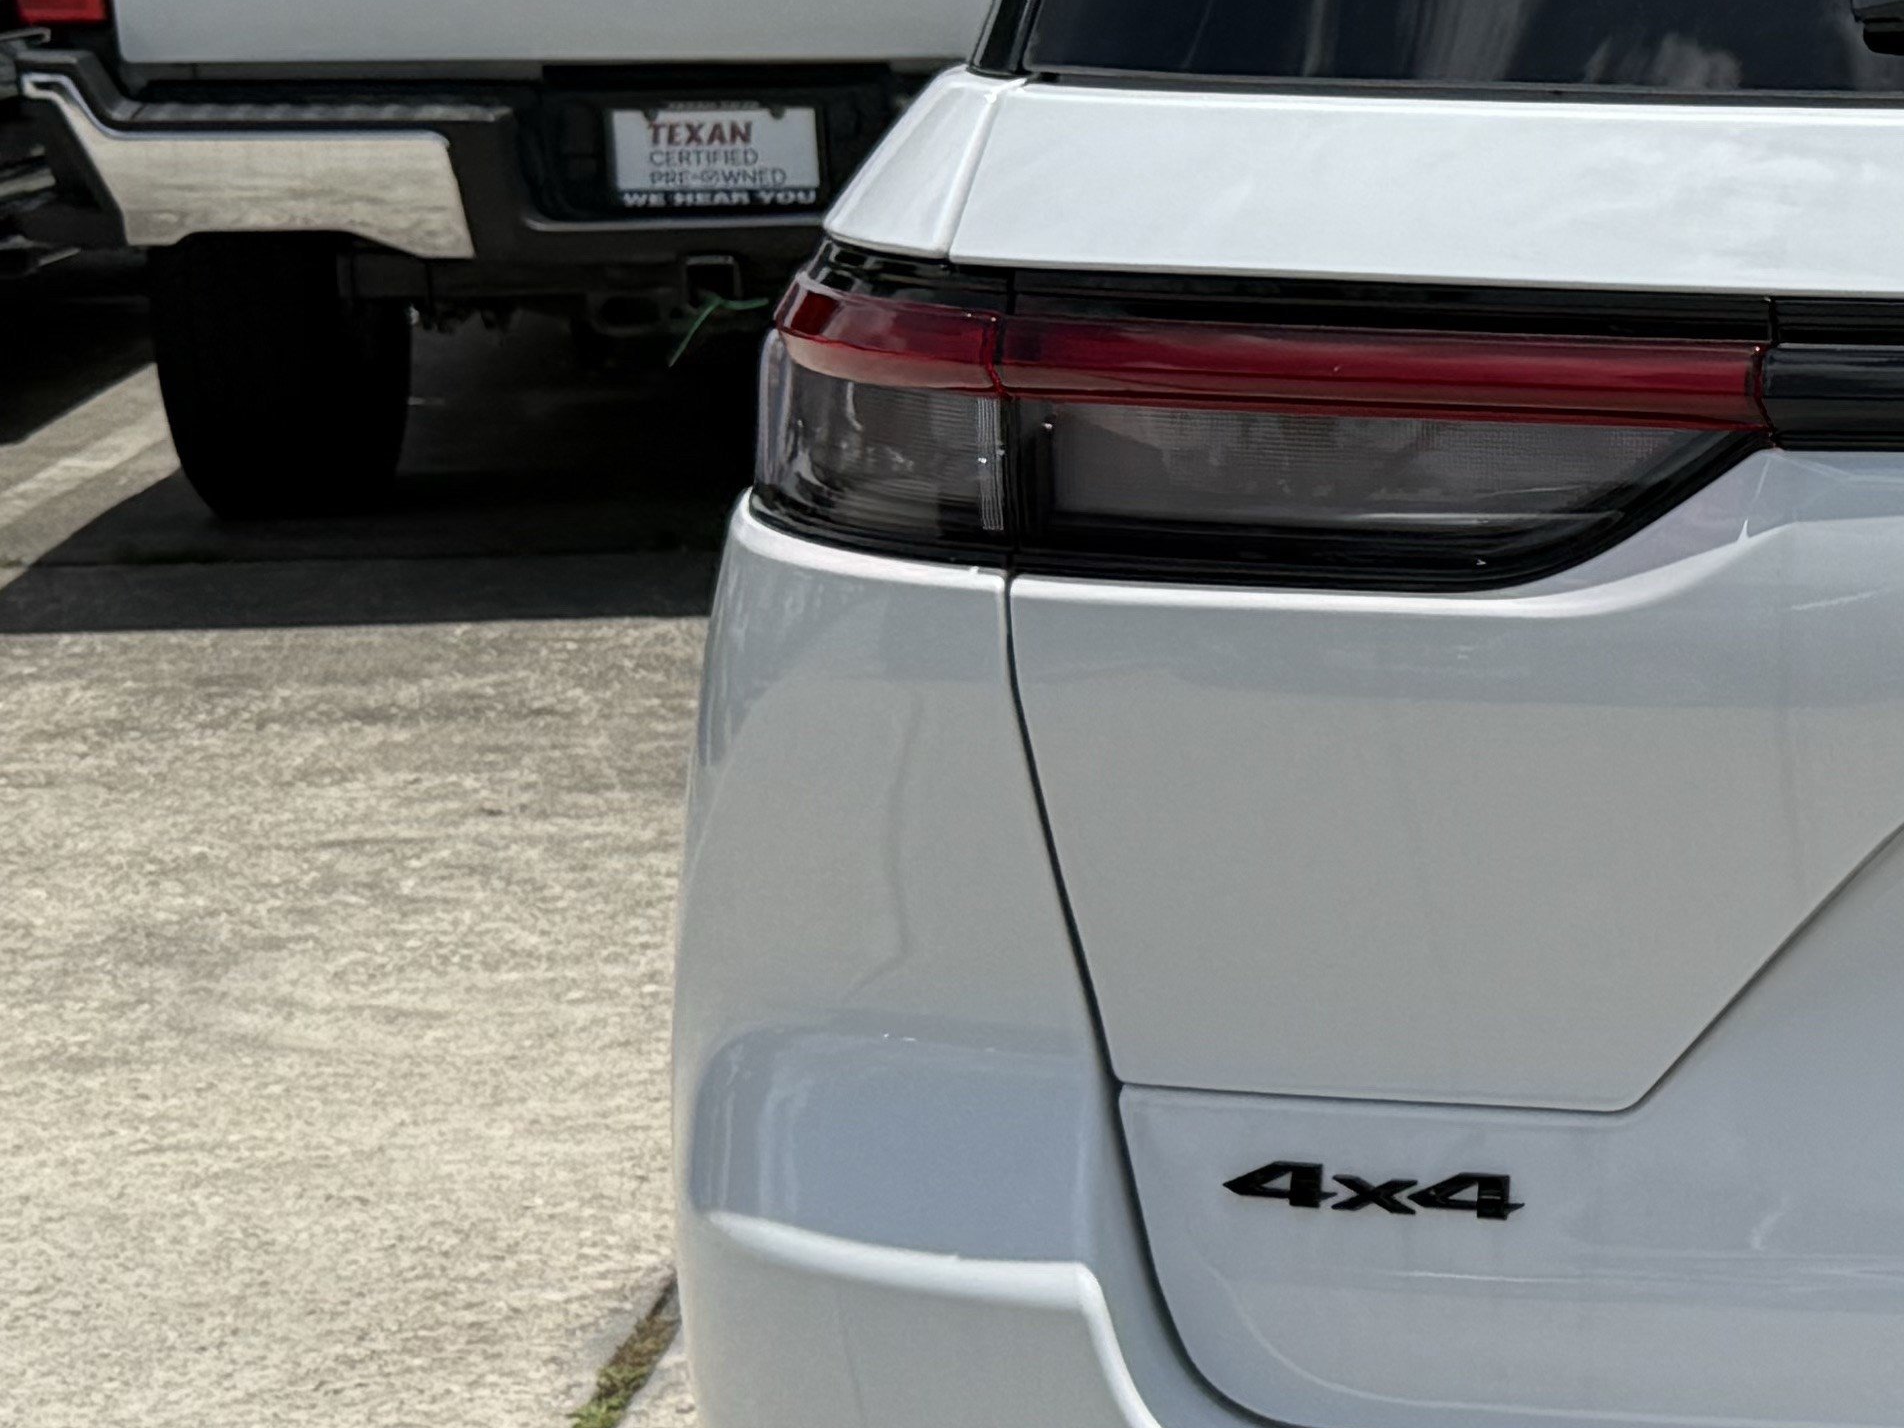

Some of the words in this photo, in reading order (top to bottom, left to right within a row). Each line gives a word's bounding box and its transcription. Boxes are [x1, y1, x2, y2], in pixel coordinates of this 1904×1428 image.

[648, 121, 752, 146] TEXAN
[650, 148, 759, 167] CERTIFIED
[622, 192, 666, 208] WE
[673, 191, 750, 207] HEAR
[756, 190, 817, 205] YOU
[1222, 1160, 1526, 1221] 4x4
